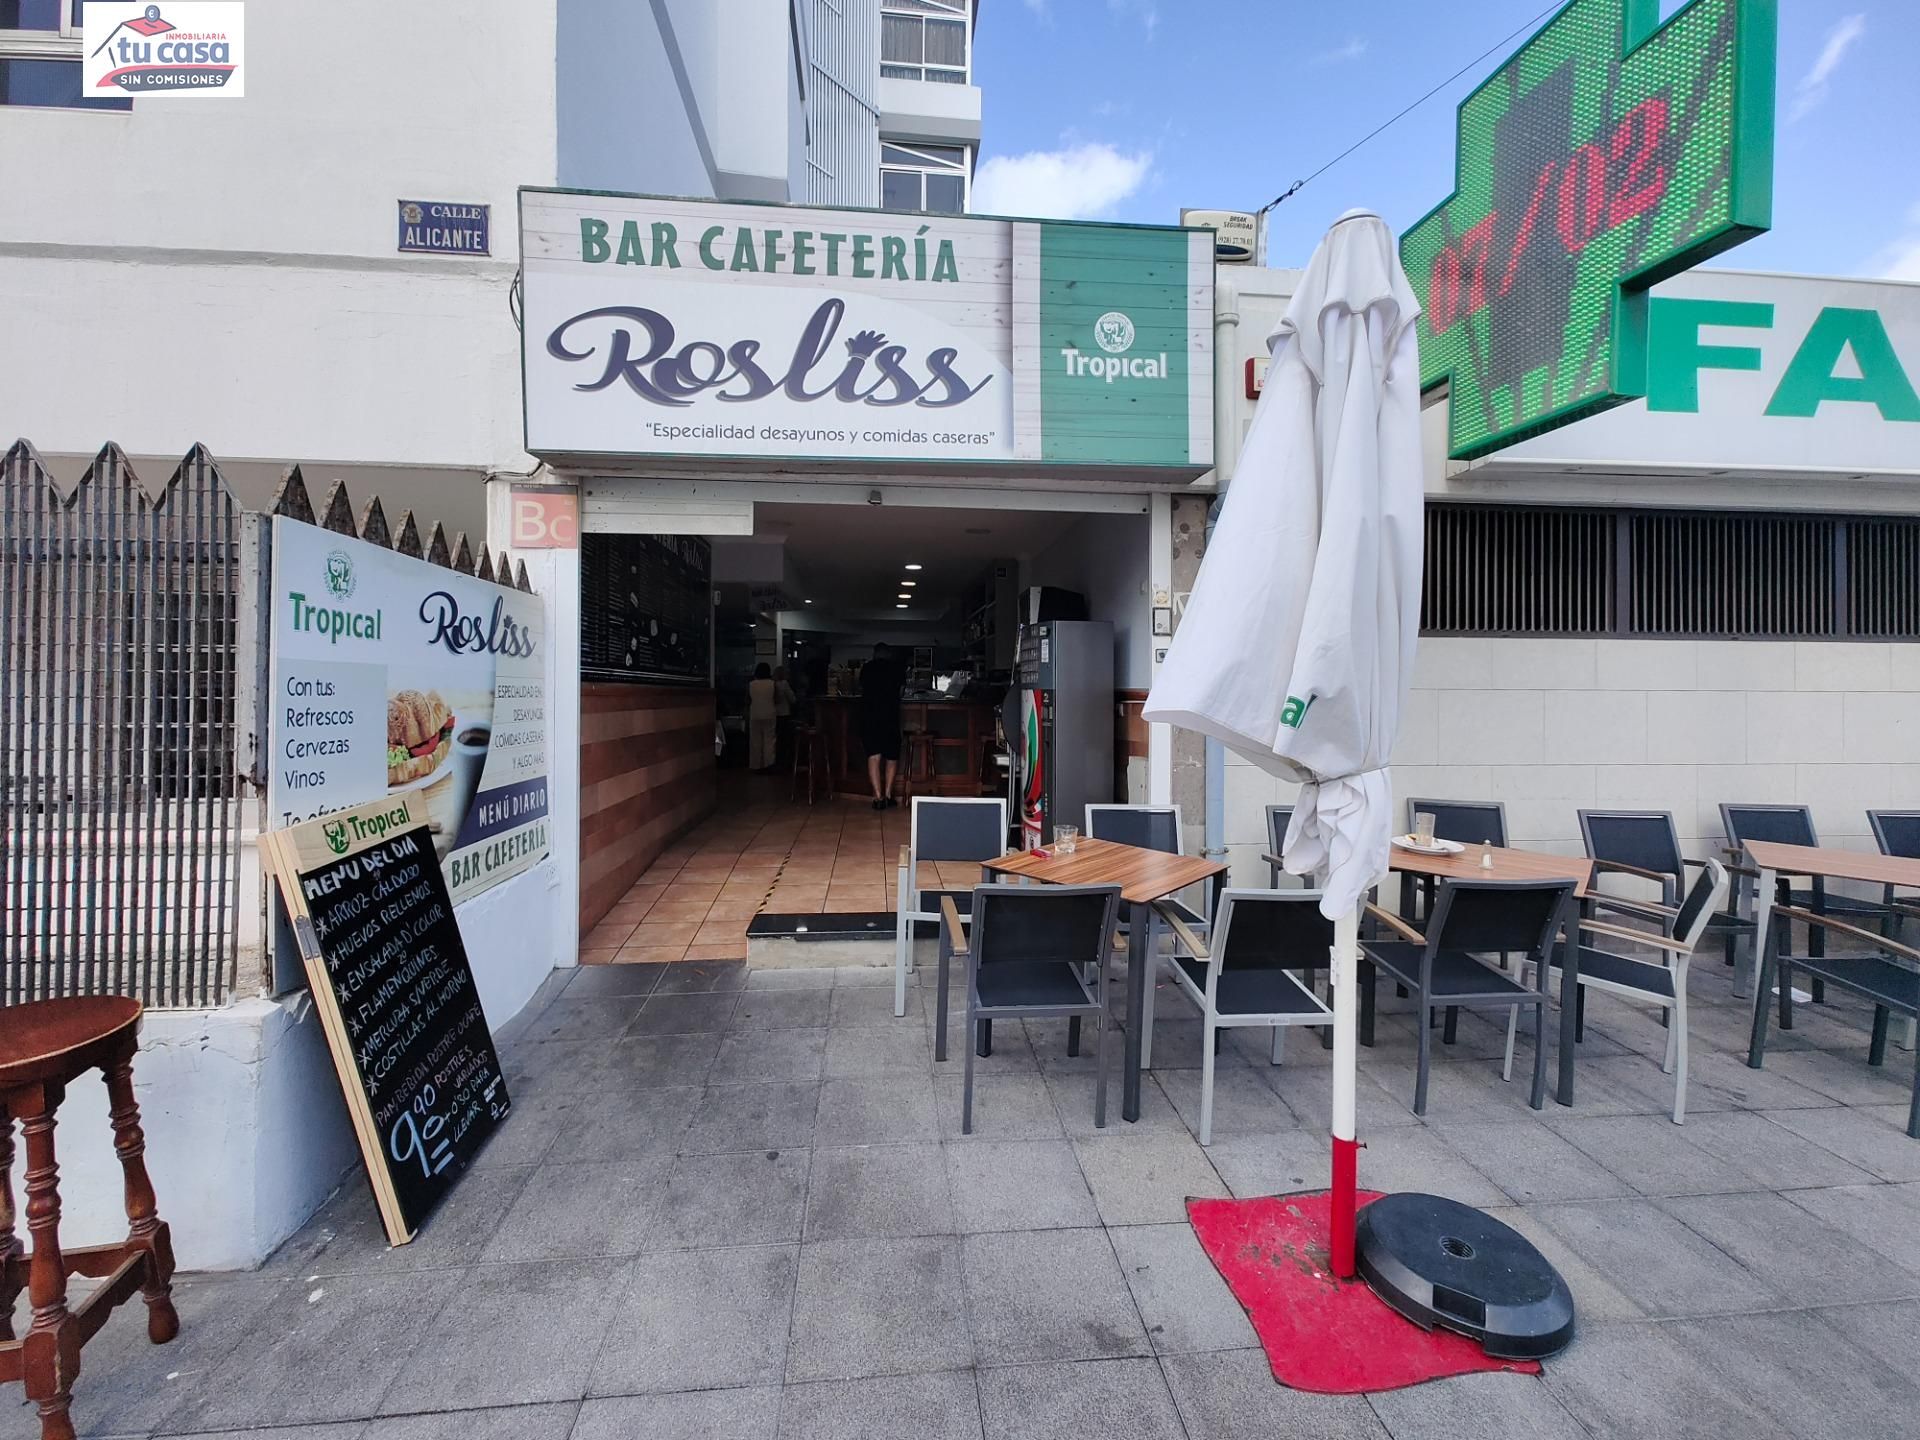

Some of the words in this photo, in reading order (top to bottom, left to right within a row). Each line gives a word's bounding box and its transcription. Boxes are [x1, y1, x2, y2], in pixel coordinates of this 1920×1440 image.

[430, 205, 482, 220] CALLE
[405, 226, 483, 250] ALICANTE
[580, 217, 682, 269] BAR
[698, 224, 961, 283] CAFETERÍA
[546, 297, 995, 408] Rosliss
[1061, 348, 1168, 384] Tropical
[1647, 296, 1920, 422] FA
[760, 425, 846, 444] desayunos
[848, 430, 859, 445] y
[862, 428, 929, 444] comidas
[514, 500, 573, 543] Bc
[289, 591, 382, 644] Tropical
[418, 590, 538, 658] Rosliss
[287, 676, 313, 698] Con
[315, 677, 336, 697] tus:
[498, 685, 534, 698] ESPECIALIDAD
[286, 706, 354, 729] Refrescos
[513, 708, 544, 721] DESAYUNOS
[285, 738, 351, 760] Cervezas
[495, 733, 521, 748] COMIDAS
[522, 729, 544, 744] CASERAS
[284, 769, 327, 790] Vinos
[516, 753, 533, 768] ALGO
[346, 799, 411, 841] Tropical
[479, 794, 510, 828] MENÚ
[513, 787, 546, 816] DIARIO
[303, 859, 360, 901] MENU
[361, 849, 395, 873] DEL
[390, 834, 420, 859] DIA
[451, 851, 481, 889] BAR
[485, 821, 547, 873] CAFETERÍA
[327, 892, 371, 931] ARROZ
[371, 862, 421, 901] CALDOSO
[336, 919, 381, 961] HUEVOS
[374, 1013, 427, 1079] COSTILLAS
[425, 1001, 440, 1021] AL
[436, 967, 468, 1009] HORNO
[433, 1045, 474, 1089] POSTRES
[469, 1065, 491, 1093] PARA
